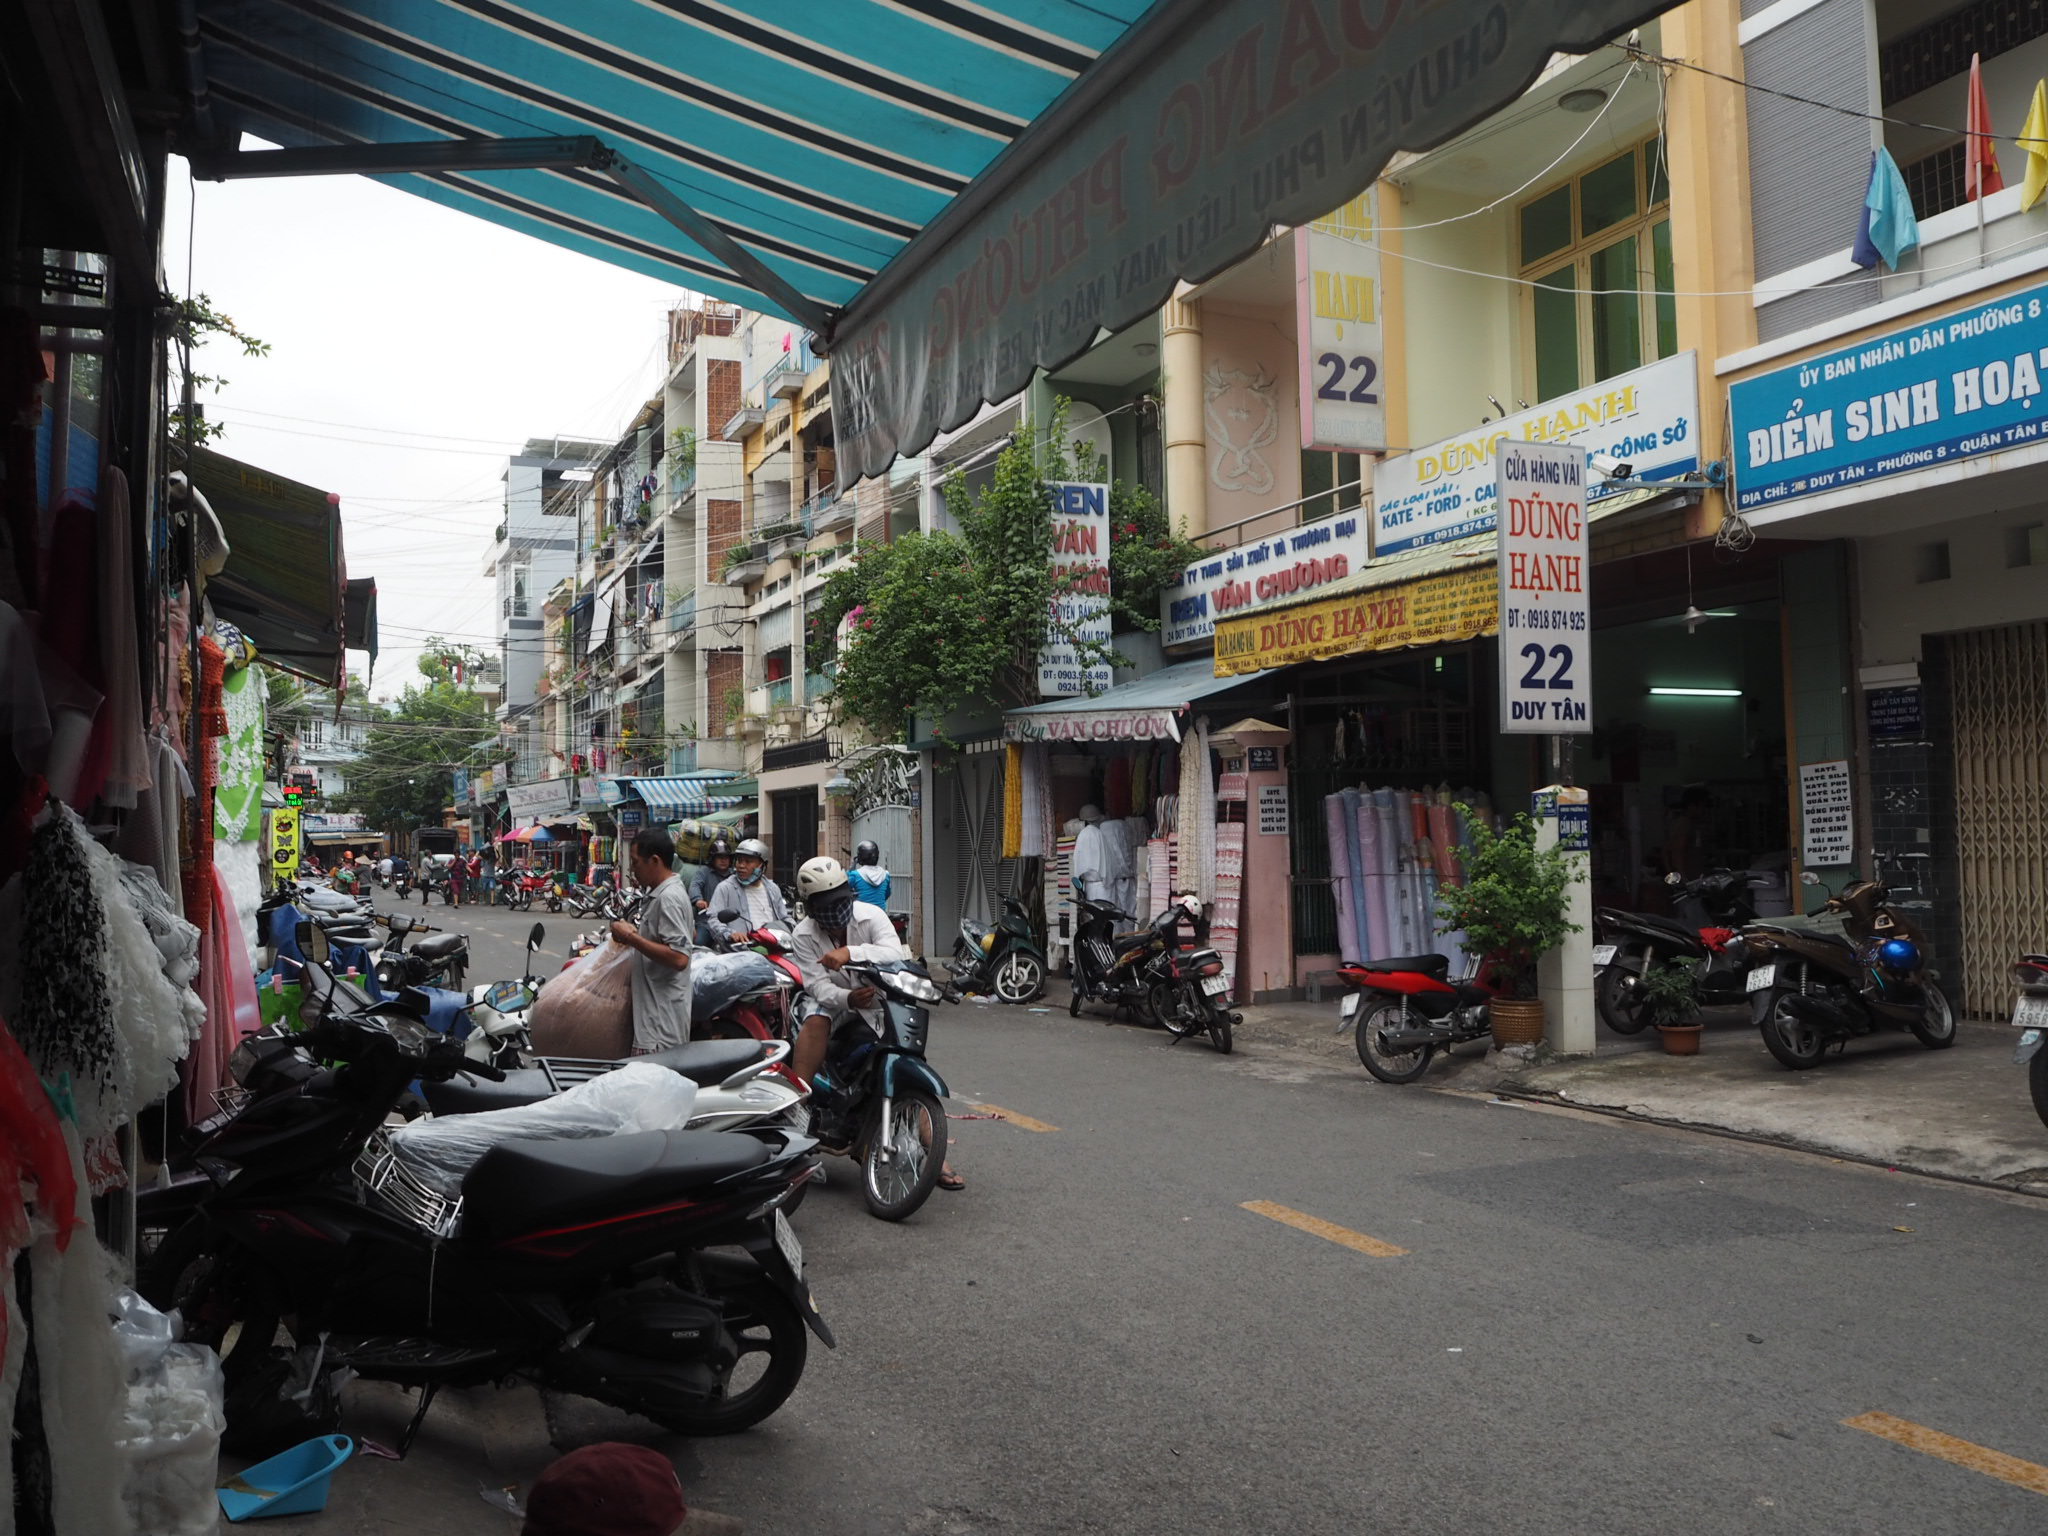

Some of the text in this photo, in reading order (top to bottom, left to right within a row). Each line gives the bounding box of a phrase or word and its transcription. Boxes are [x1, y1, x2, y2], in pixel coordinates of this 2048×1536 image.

[1800, 299, 2040, 388] ỦY BAN NHÂN DÂN PHƯỜNG 8
[1317, 352, 1378, 404] 22
[1416, 384, 1637, 483] DŨNG HẠNH
[1747, 397, 1834, 468] ĐIỂM
[1845, 379, 1939, 442] SINH
[1382, 508, 1414, 529] KATE
[1426, 495, 1461, 517] FORD
[1611, 436, 1657, 459] CÔNG
[1662, 418, 1688, 445] SỞ
[1506, 449, 1528, 481] CỬA
[1531, 455, 1560, 485] HÀNG
[1563, 454, 1581, 486] VẢI
[1741, 491, 1761, 506] ĐỊA
[1810, 473, 1835, 488] DUY
[1838, 465, 1865, 481] TÂN
[1877, 448, 1933, 472] PHƯỜNG
[1937, 446, 1946, 458] 8
[1960, 432, 2001, 453] QUẬN
[2005, 422, 2037, 441] TÂN
[1050, 518, 1097, 555] VĂN
[1434, 517, 1497, 541] 0918.874.92
[1508, 492, 1581, 542] DŨNG
[1211, 580, 1252, 612] VĂN
[1256, 553, 1349, 601] CHƯƠNG
[1509, 552, 1582, 600] HẠNH
[1260, 614, 1326, 652] DŨNG
[1332, 595, 1408, 641] HẠNH
[1508, 608, 1585, 631] ĐT 0918 874 925
[1520, 643, 1573, 690] 22
[1047, 717, 1086, 739] VĂN
[1091, 715, 1170, 739] CHƯƠN
[1512, 697, 1586, 721] DUY TÂN
[1253, 749, 1273, 762] 22
[1828, 772, 1848, 780] SILK
[1811, 816, 1833, 824] CÔNG
[1828, 825, 1848, 833] SINH
